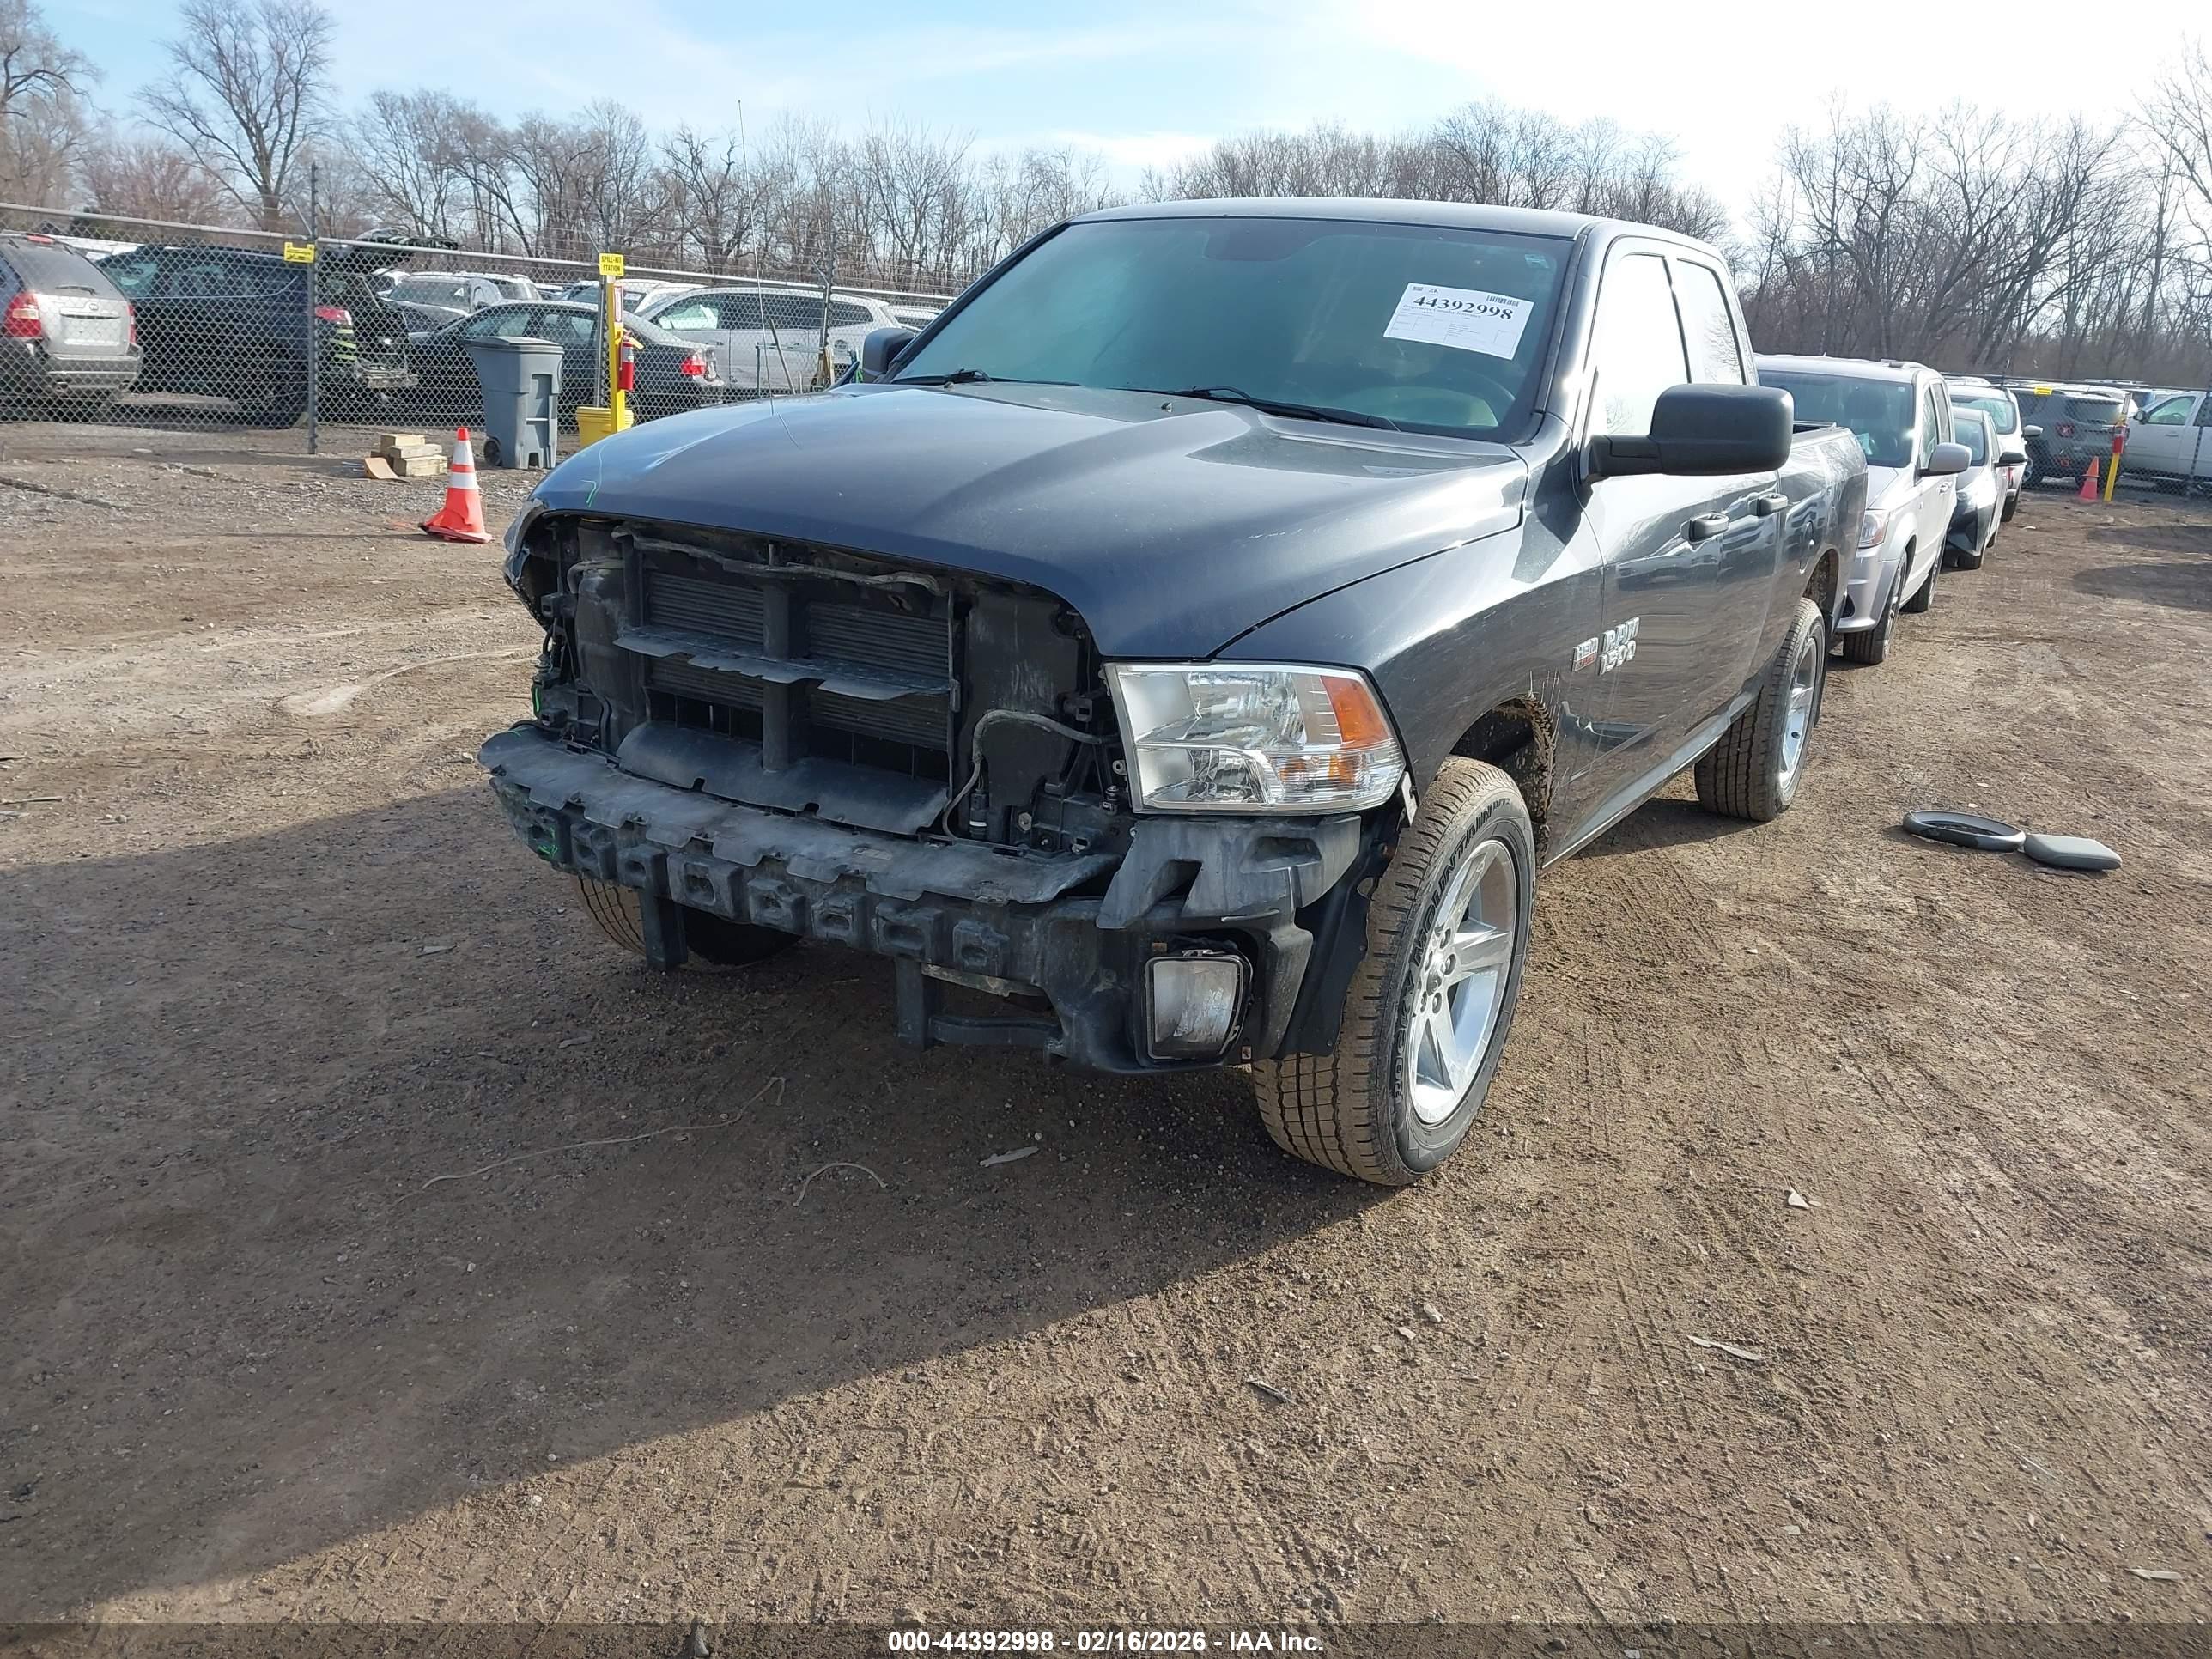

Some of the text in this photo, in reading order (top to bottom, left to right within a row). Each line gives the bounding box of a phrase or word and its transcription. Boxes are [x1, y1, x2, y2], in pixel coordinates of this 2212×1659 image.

[1413, 295, 1515, 321] 44392998
[1601, 617, 1640, 653] RAM
[1412, 805, 1492, 967] MOUNTAIN
